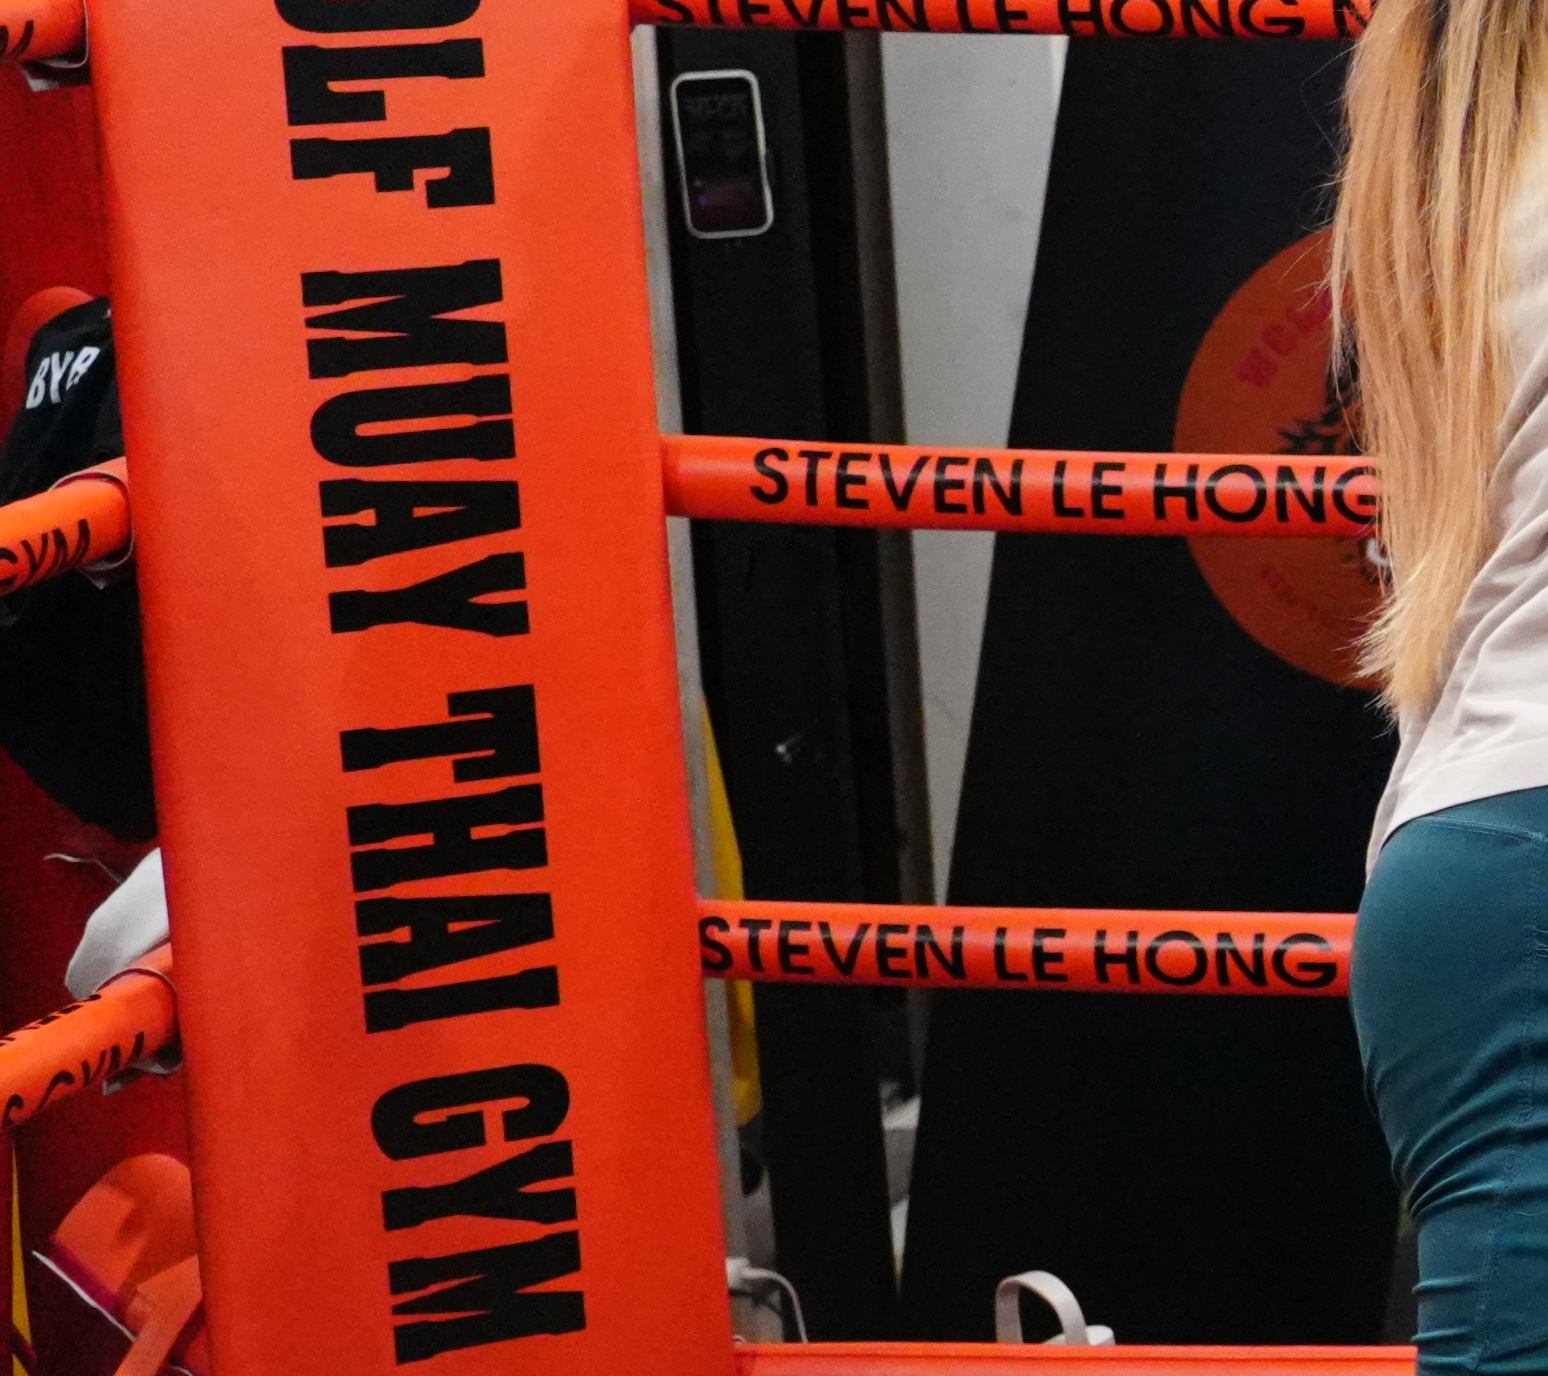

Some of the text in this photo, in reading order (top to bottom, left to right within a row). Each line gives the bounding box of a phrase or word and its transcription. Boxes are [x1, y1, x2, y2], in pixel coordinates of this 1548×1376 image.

[300, 257, 531, 638] MUAY
[749, 447, 1378, 525] STEVEN LE HONG
[339, 683, 561, 1035] THAI
[698, 916, 1339, 990] STEVEN LE HONG
[370, 1061, 587, 1366] GYM
